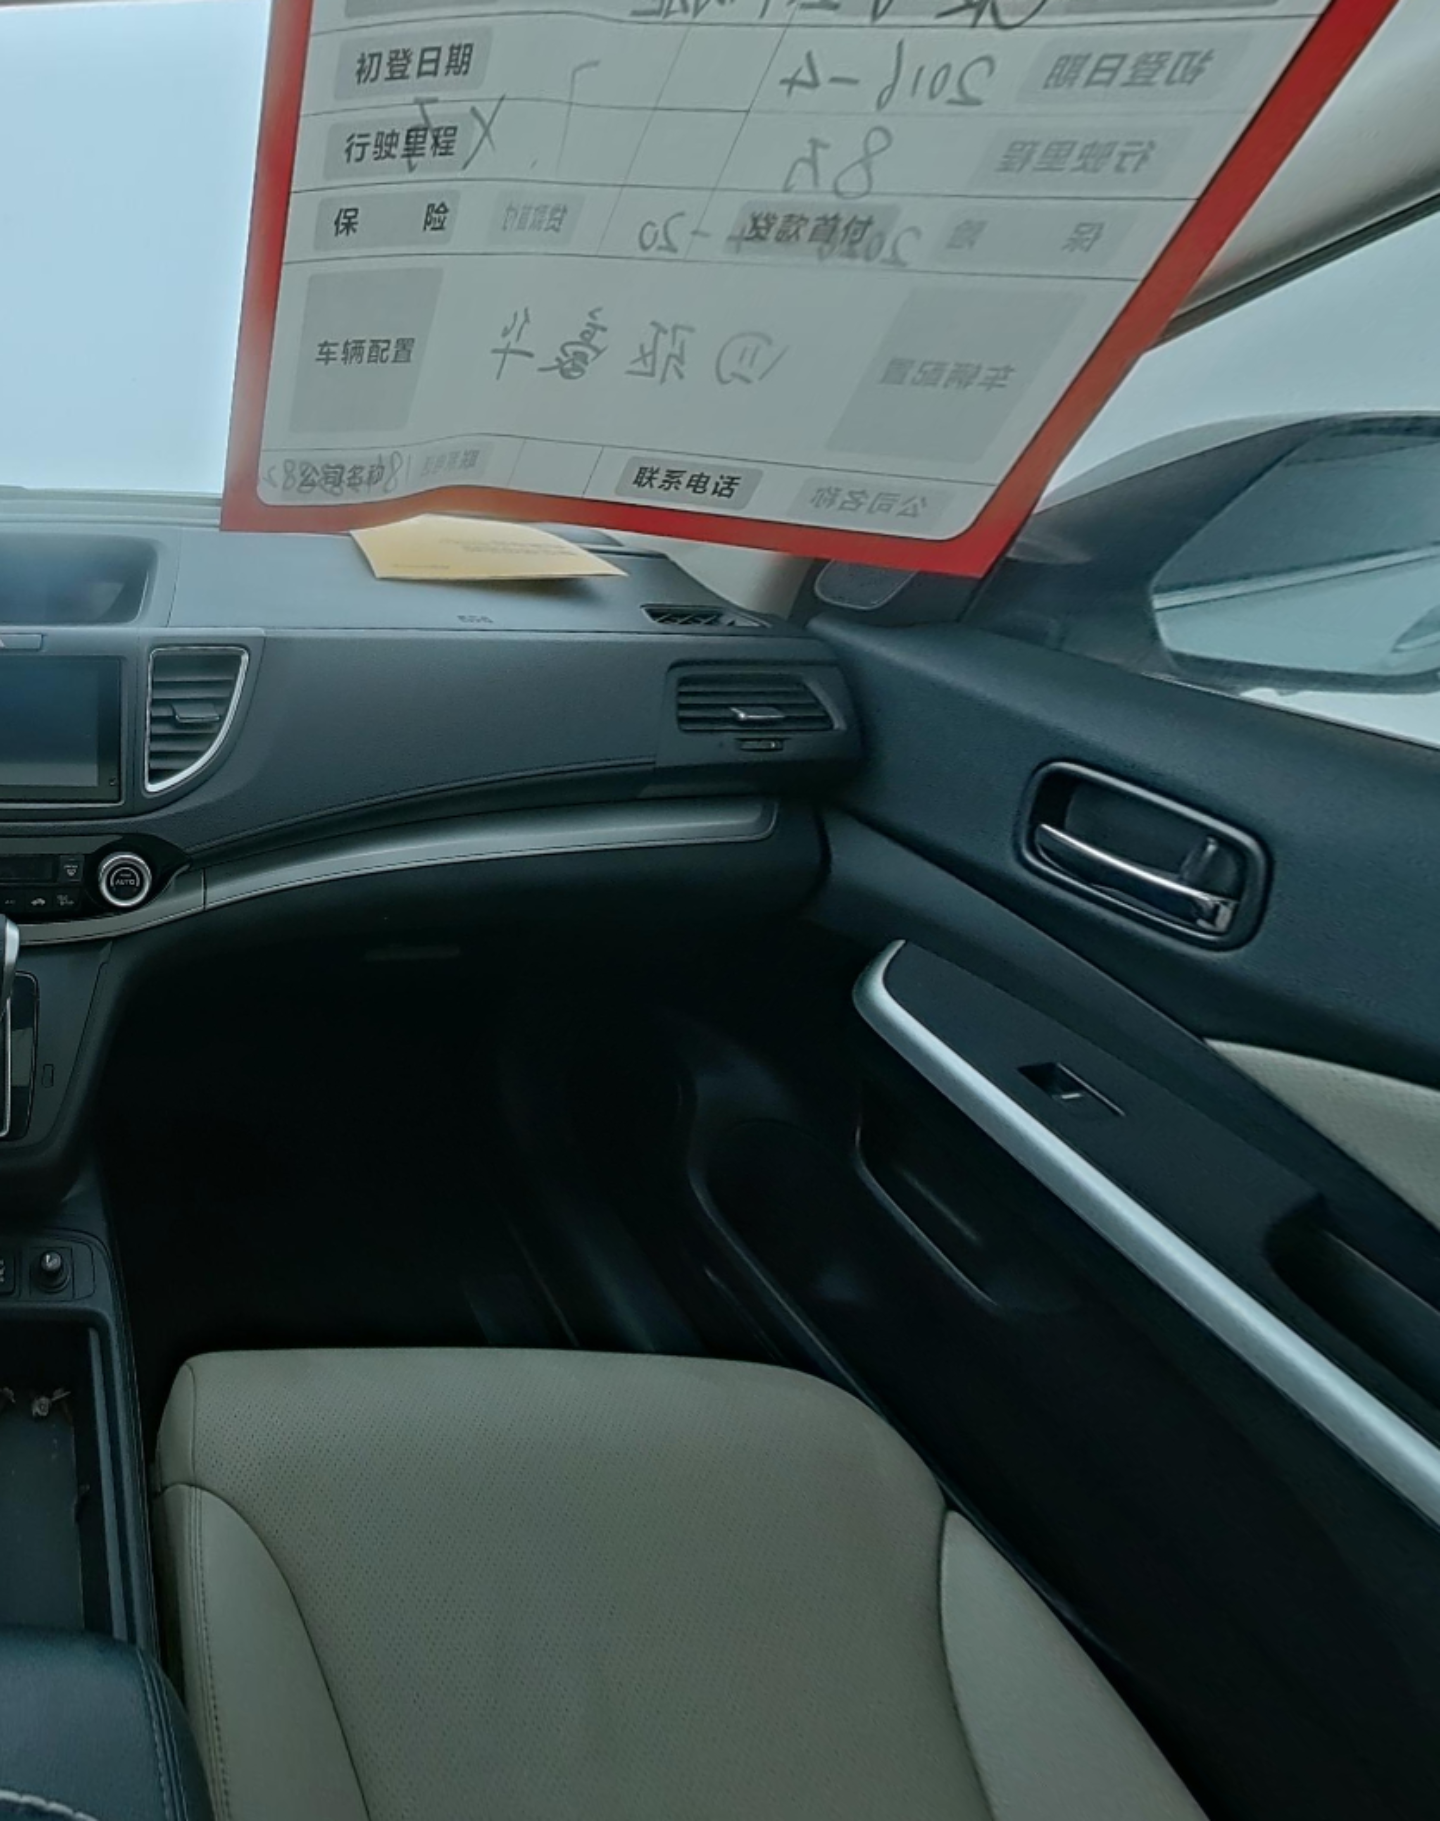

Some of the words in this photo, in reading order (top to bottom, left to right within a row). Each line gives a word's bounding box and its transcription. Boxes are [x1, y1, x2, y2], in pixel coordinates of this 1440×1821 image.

[354, 42, 474, 86] 初登日期
[344, 124, 459, 165] 行驶里程
[315, 336, 417, 367] 车辆配置
[632, 466, 743, 500] 联系电话
[115, 878, 136, 886] AUTO
